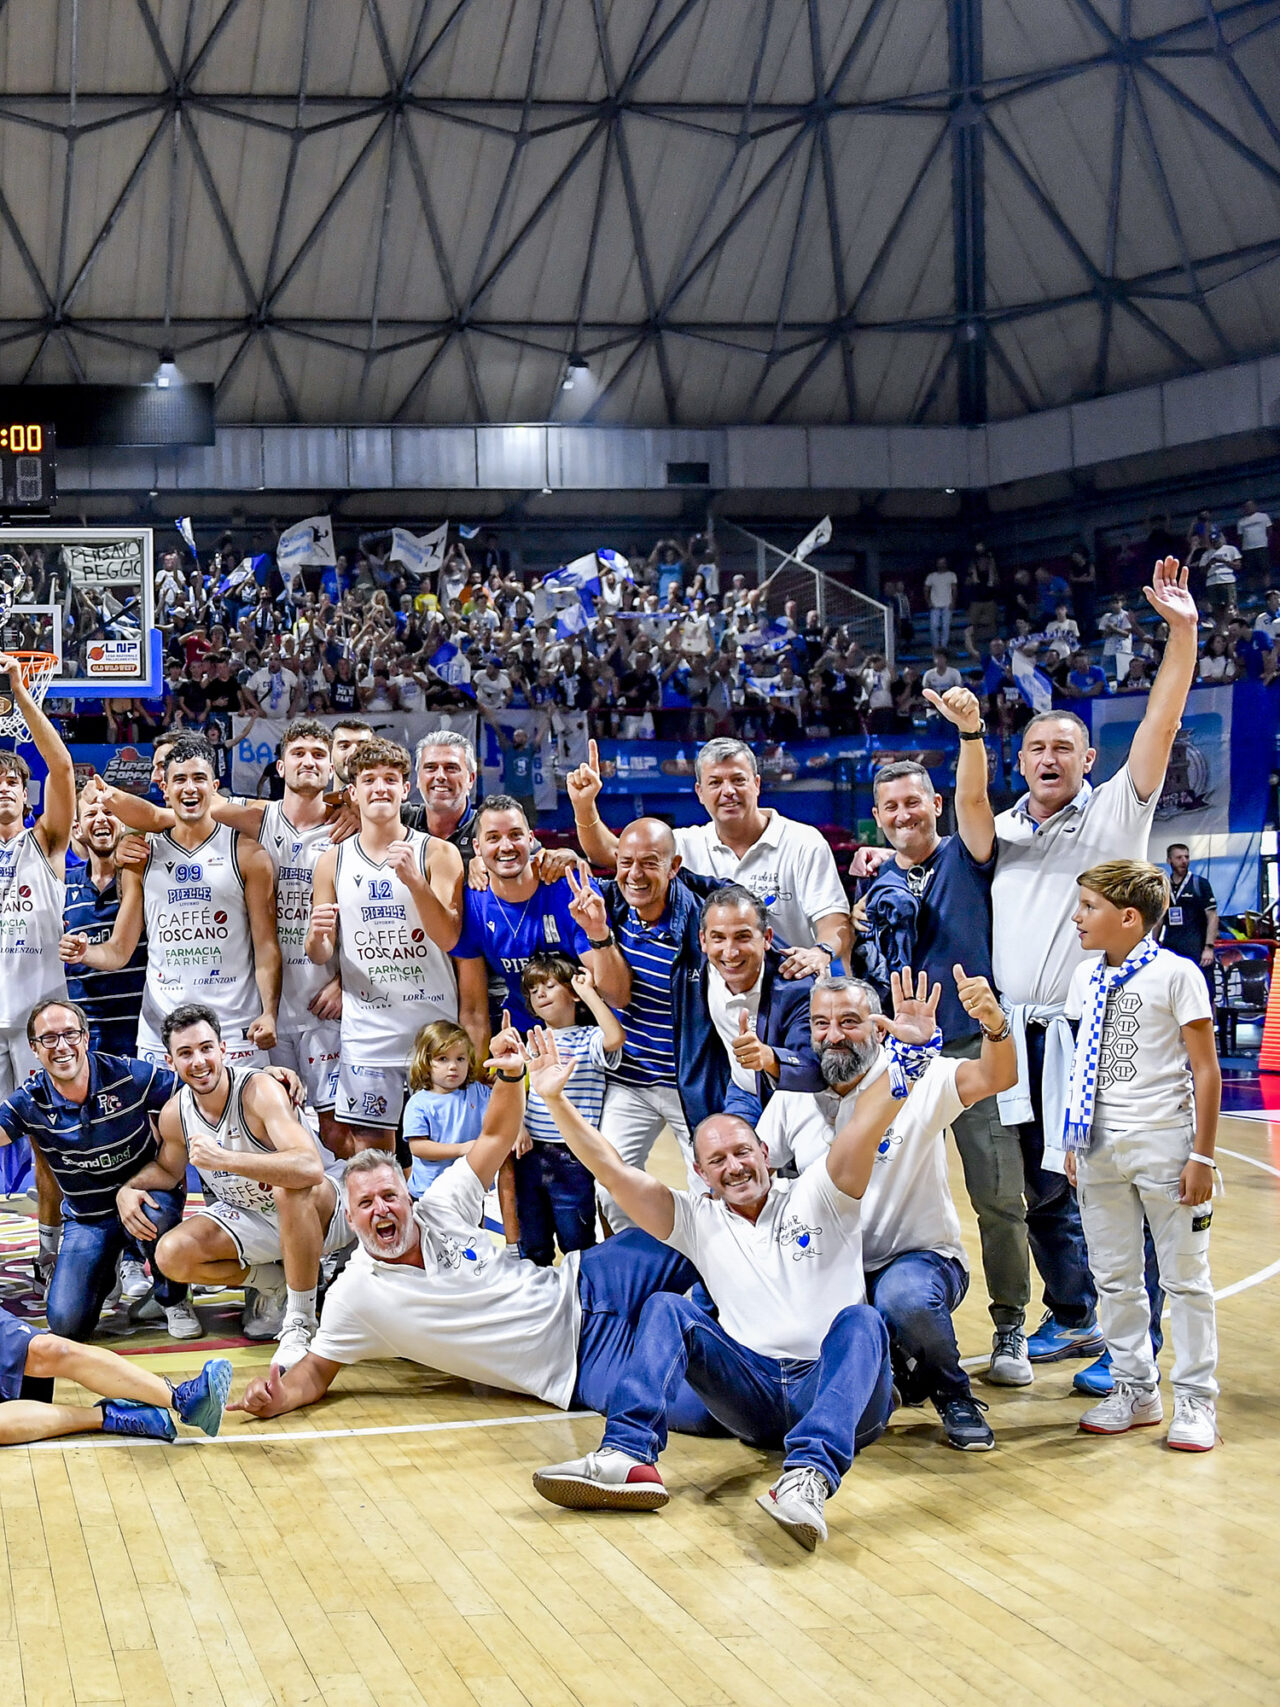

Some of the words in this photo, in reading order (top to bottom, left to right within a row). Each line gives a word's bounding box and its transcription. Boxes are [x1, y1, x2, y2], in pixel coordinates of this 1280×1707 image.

[105, 643, 137, 653] LNP
[104, 771, 151, 782] COPPA
[175, 863, 203, 883] 99
[168, 887, 211, 904] PIELLE
[277, 889, 310, 906] AFFÉ
[368, 880, 393, 900] 12
[157, 906, 210, 929] CAFFÉ
[361, 905, 406, 922] PIELLE
[158, 926, 229, 944] TOSCANO
[354, 925, 408, 945] CAFFÉ
[165, 946, 221, 958] FARMACIA
[357, 945, 427, 960] TOSCANO
[166, 955, 223, 967] FARNETI
[193, 976, 237, 985] LORENZONI
[687, 969, 701, 978] EA
[230, 1050, 255, 1060] ZAKI
[320, 1052, 339, 1062] ZAK
